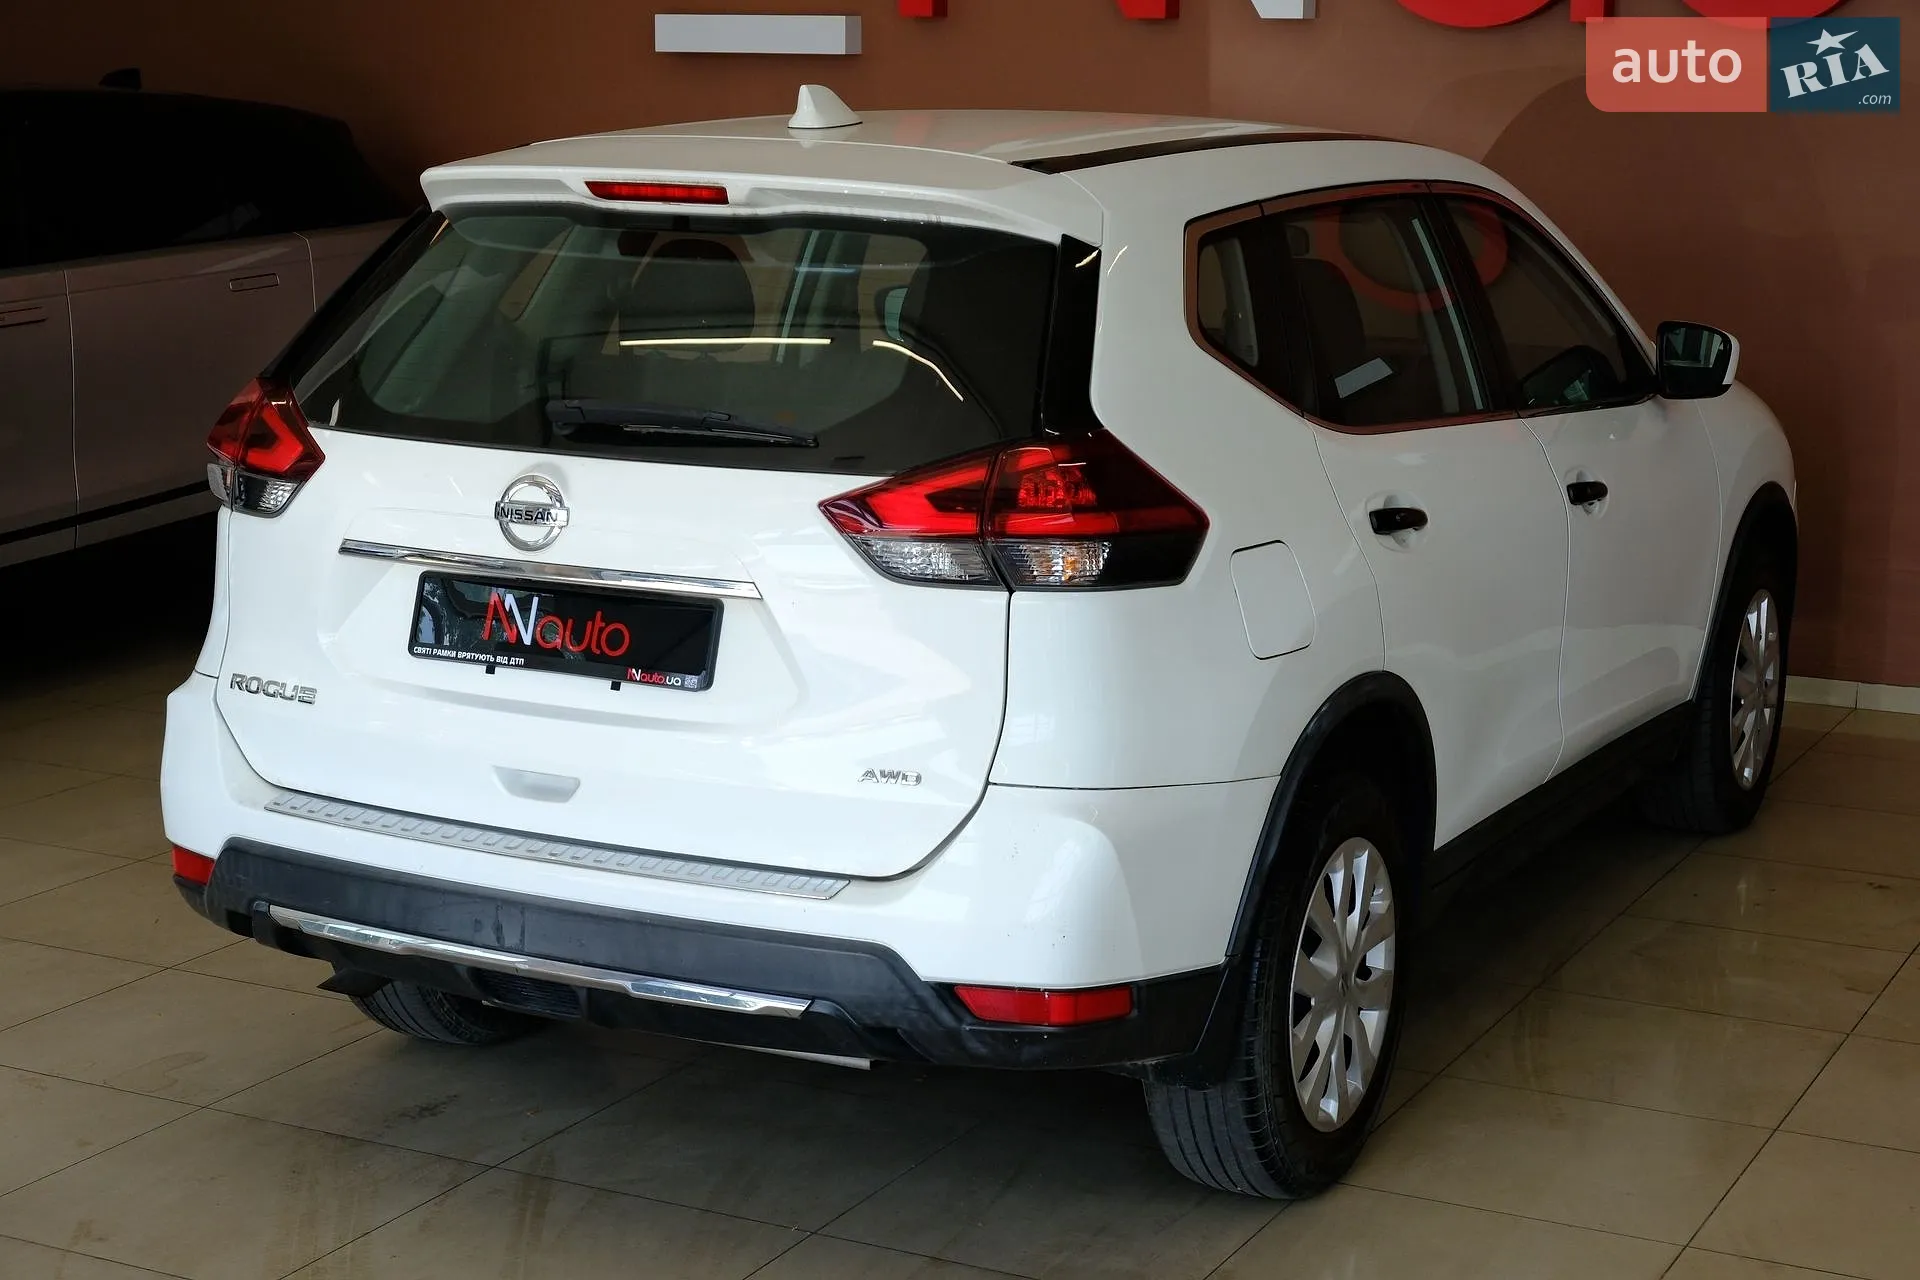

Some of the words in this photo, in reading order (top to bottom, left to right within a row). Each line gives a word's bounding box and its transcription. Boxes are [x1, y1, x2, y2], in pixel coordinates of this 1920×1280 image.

[500, 506, 559, 523] NISSAN
[413, 646, 432, 655] СВЯТІ
[432, 648, 457, 658] РАМКИ
[457, 651, 495, 663] ВРЯТУЮТЬ
[496, 655, 508, 664] ВІД
[509, 657, 525, 666] ДТП
[230, 673, 318, 705] ROGUE
[858, 767, 922, 787] AWD
